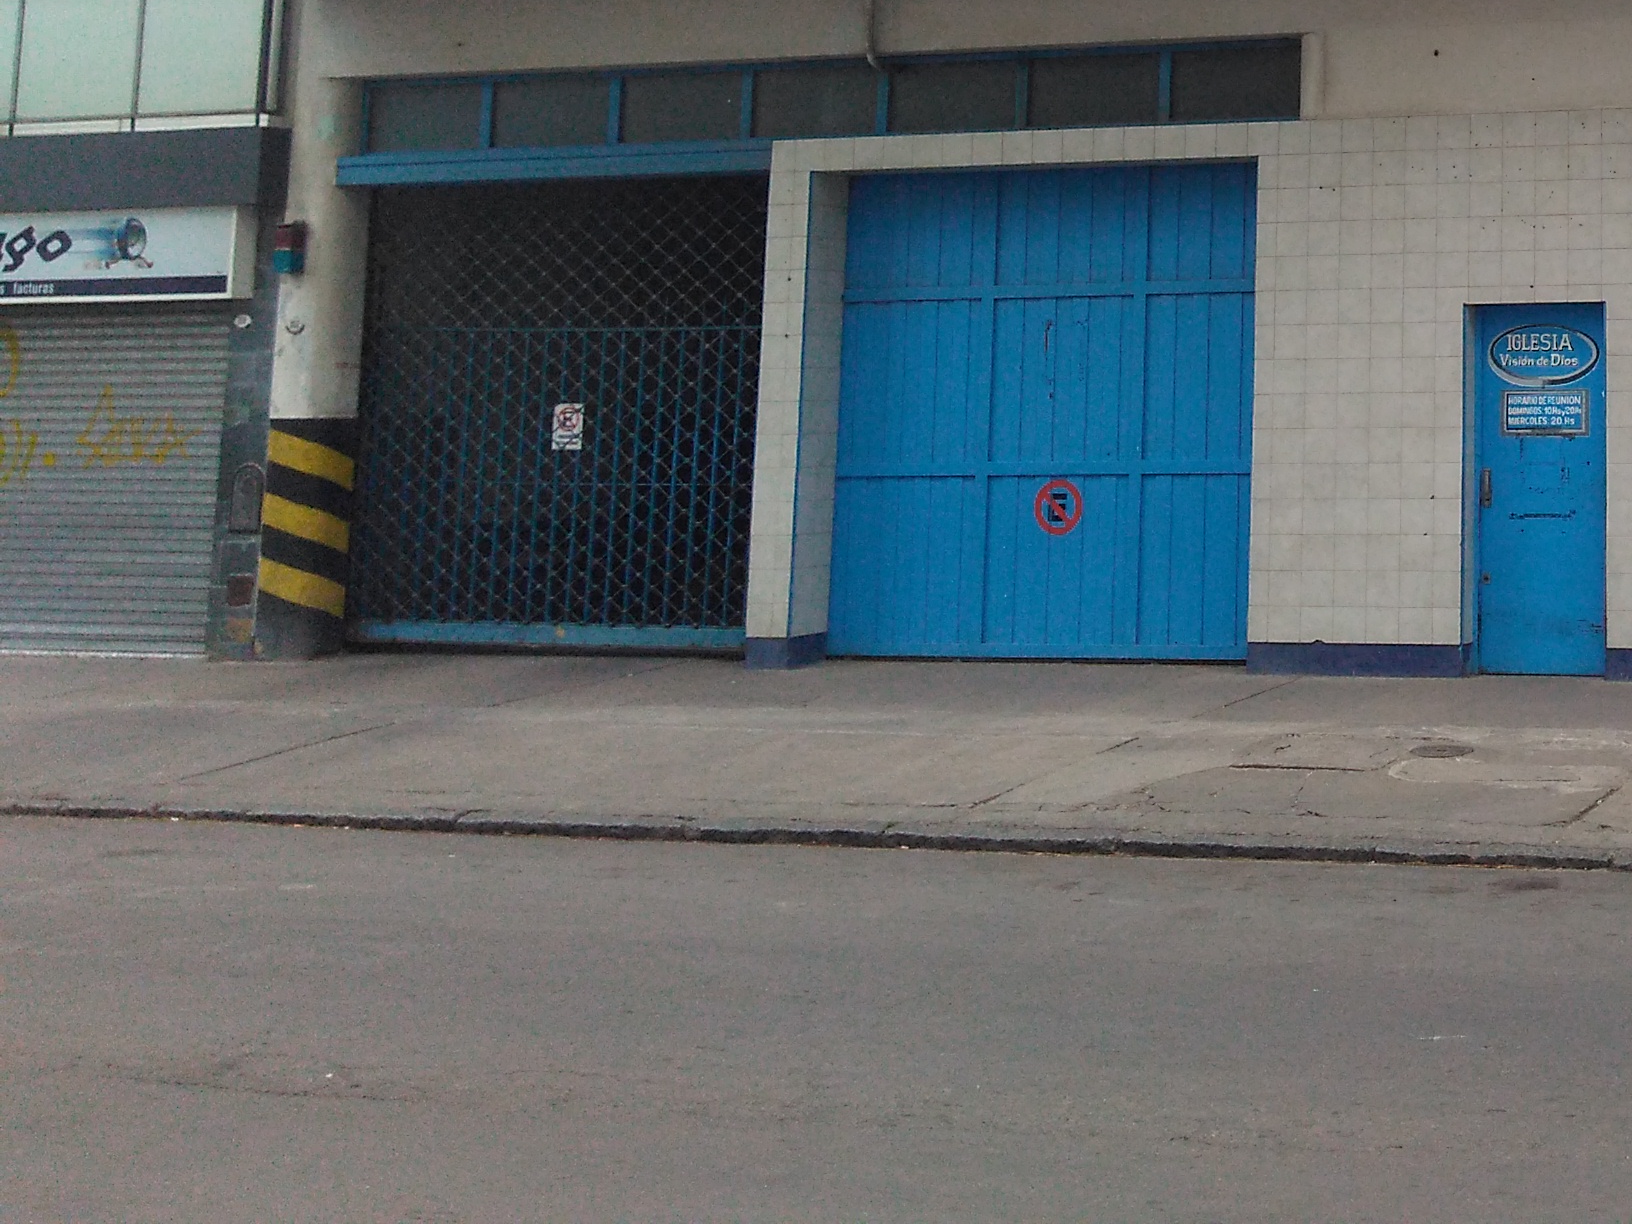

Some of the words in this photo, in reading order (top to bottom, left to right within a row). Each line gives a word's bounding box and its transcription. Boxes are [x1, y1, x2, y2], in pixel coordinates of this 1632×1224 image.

[0, 225, 72, 273] go
[13, 282, 55, 295] facturas
[1506, 333, 1574, 351] IGLESIA
[1499, 353, 1535, 367] Visión
[1536, 355, 1549, 366] de
[1550, 353, 1579, 367] Dios
[1538, 396, 1547, 405] DE
